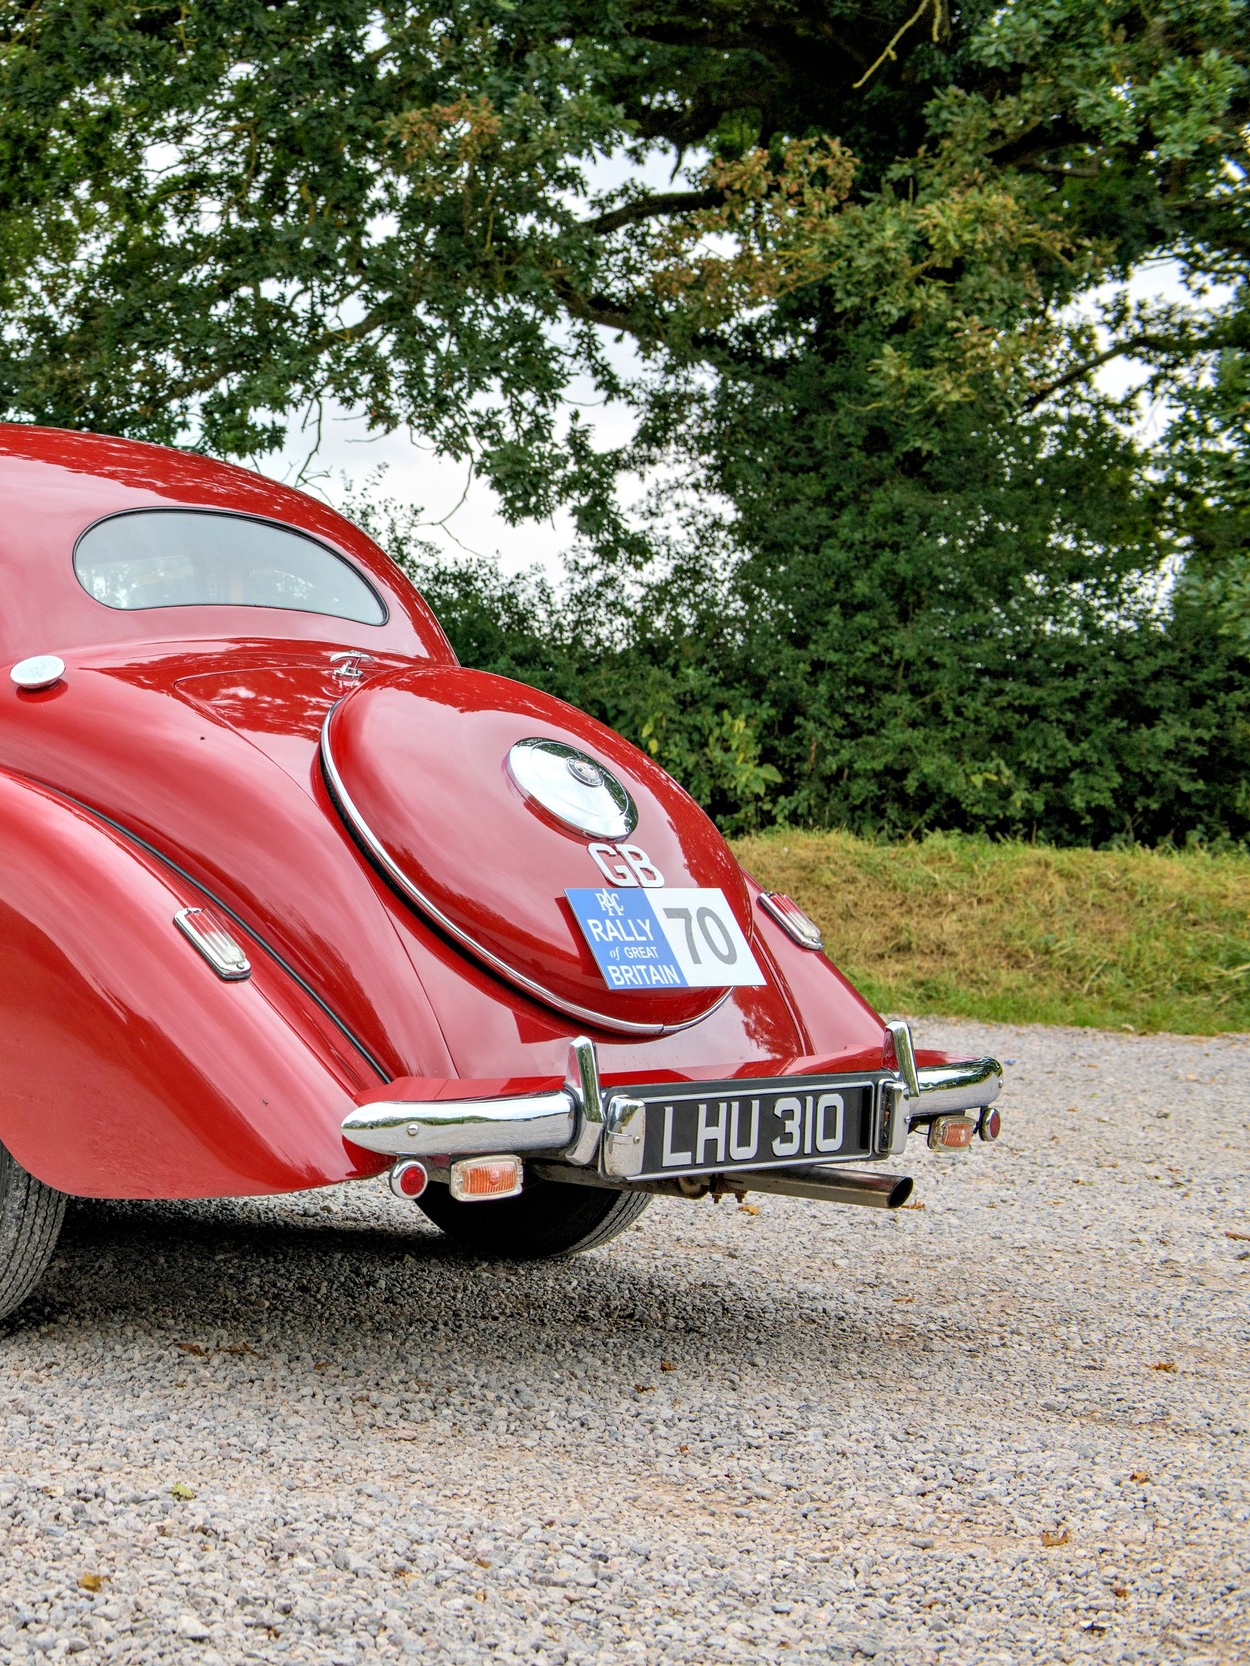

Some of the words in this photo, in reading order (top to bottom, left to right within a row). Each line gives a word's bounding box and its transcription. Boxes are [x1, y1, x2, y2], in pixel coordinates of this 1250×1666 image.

[588, 843, 664, 887] GB
[587, 919, 654, 941] RALLY
[663, 907, 737, 965] 70
[609, 947, 620, 960] of
[624, 946, 658, 959] GREAT
[608, 964, 680, 985] BRITAIN
[662, 1100, 759, 1167] LHU
[772, 1094, 844, 1157] 310
